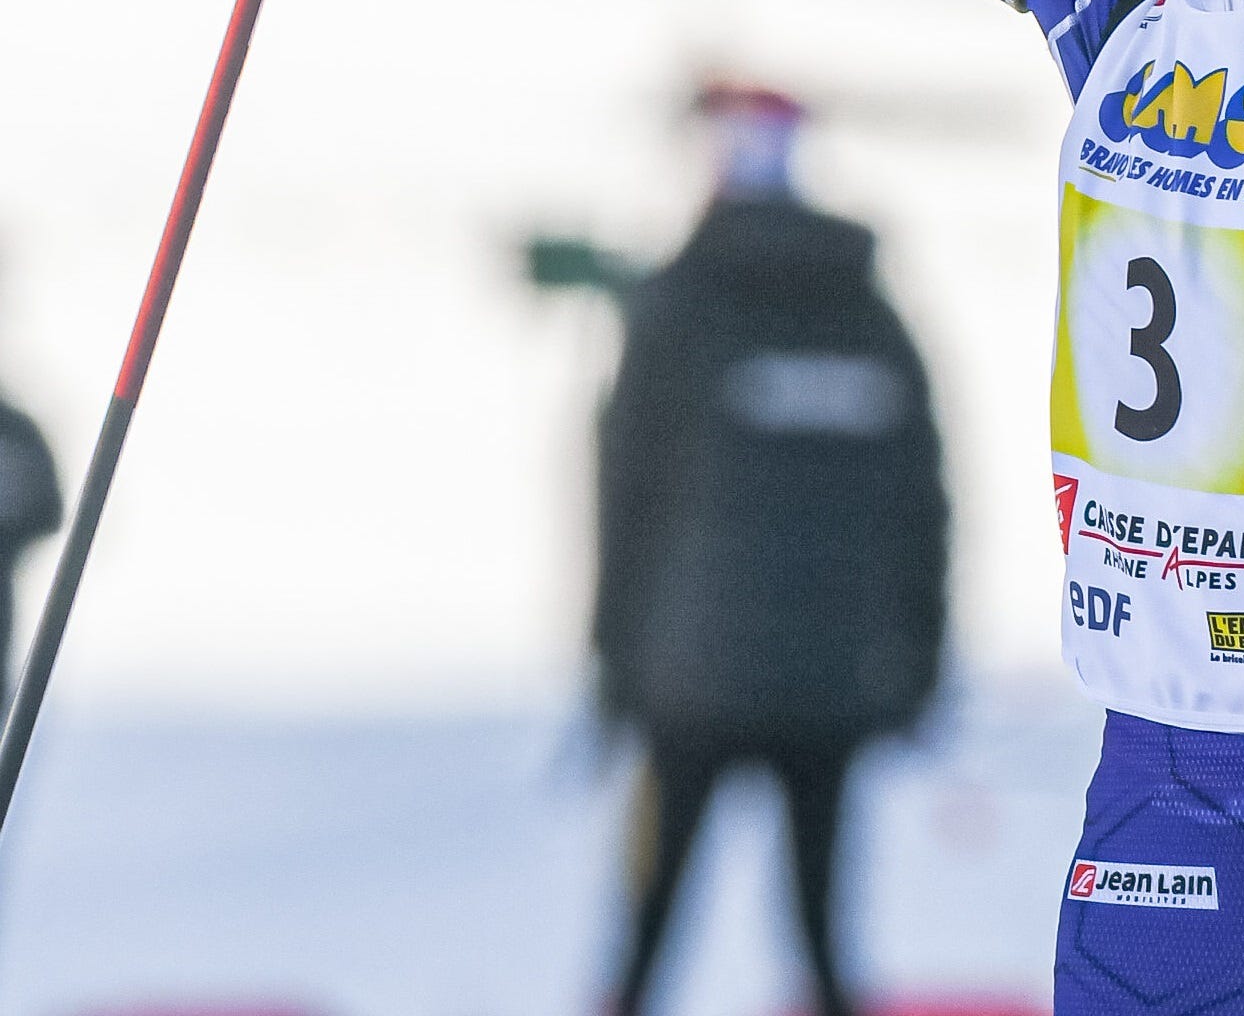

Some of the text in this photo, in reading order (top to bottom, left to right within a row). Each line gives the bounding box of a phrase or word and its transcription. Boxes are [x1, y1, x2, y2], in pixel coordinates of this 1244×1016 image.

[1114, 257, 1183, 442] 3
[1215, 633, 1236, 647] DU
[1096, 869, 1213, 895] Jean Lain
